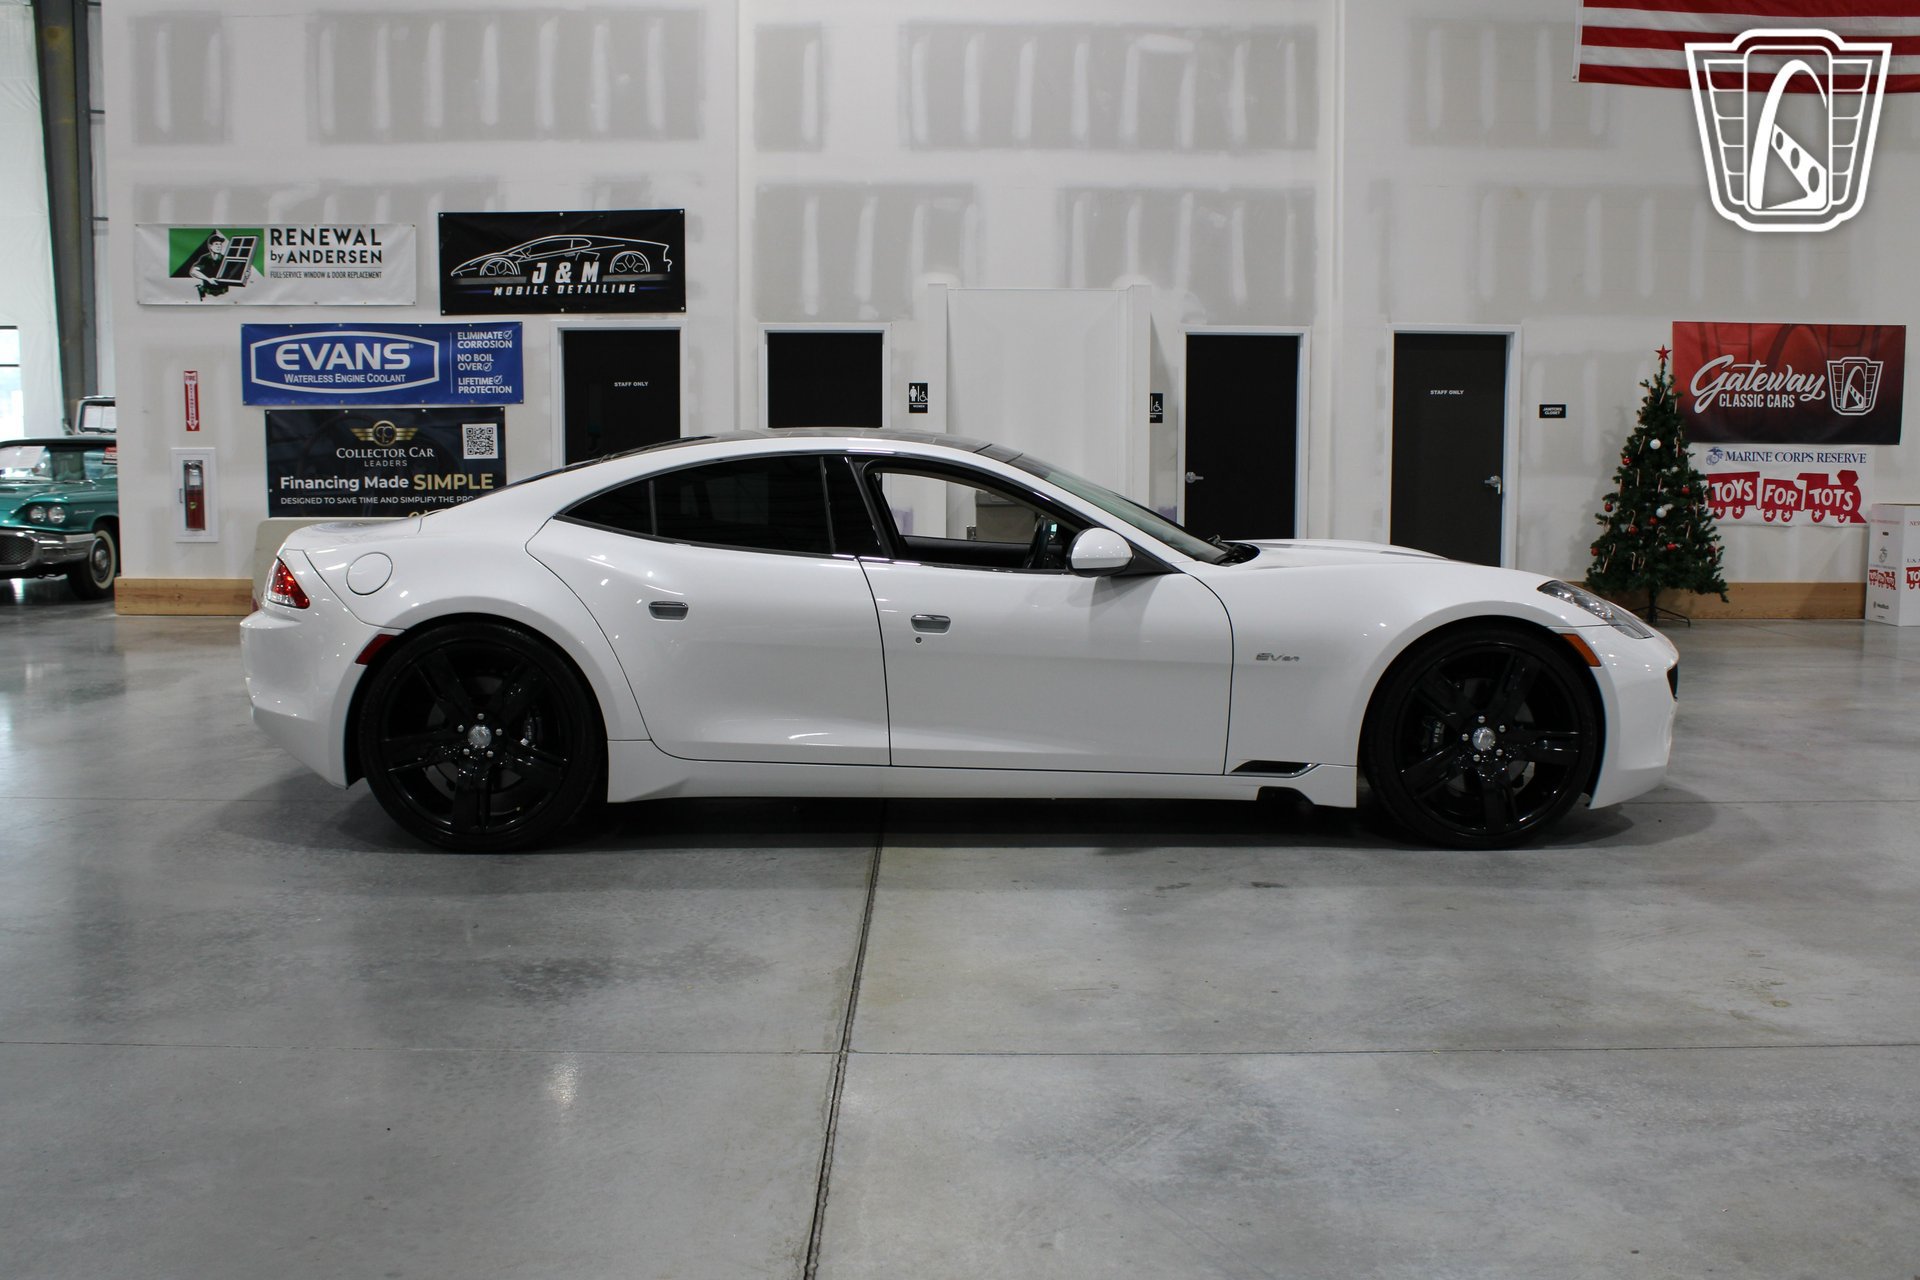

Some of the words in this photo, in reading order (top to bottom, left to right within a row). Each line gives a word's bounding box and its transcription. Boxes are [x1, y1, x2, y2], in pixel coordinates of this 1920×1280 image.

[270, 228, 381, 245] RENEWAL
[270, 250, 284, 265] by
[286, 250, 382, 263] ANDERSEN
[303, 271, 326, 279] WINDOW
[326, 271, 331, 279] &
[332, 271, 347, 279] DOOR
[347, 271, 382, 279] REPLACEMENT
[531, 262, 548, 284] J
[555, 262, 571, 283] &
[581, 262, 599, 282] M
[494, 286, 548, 295] MOBILE
[557, 283, 636, 294] DETAILING
[458, 331, 504, 340] ELIMINATE
[458, 340, 512, 349] CORROSION
[276, 343, 411, 370] EVANS
[457, 354, 471, 362] NO
[474, 354, 494, 362] BOIL
[458, 363, 484, 371] OVER
[458, 377, 494, 385] LIFETIME
[1690, 354, 1826, 414] Gateway
[459, 386, 512, 394] PROTECTION
[1719, 394, 1764, 407] CLASSIC
[1767, 394, 1795, 408] CARS
[409, 447, 434, 458] CAR
[1725, 450, 1773, 463] MARINE
[1775, 452, 1813, 462] CORPS
[1817, 452, 1867, 464] RESERVE
[364, 460, 407, 468] LEADERS
[281, 476, 359, 491] Financing
[365, 475, 409, 488] Made
[414, 474, 493, 490] SIMPLE
[324, 497, 335, 505] TO
[337, 497, 357, 505] SAVE
[400, 496, 437, 504] SIMPLIFY
[438, 496, 454, 504] THE
[1712, 479, 1753, 502] TOYS
[1763, 484, 1798, 507] FOR
[1809, 488, 1853, 511] TOTS
